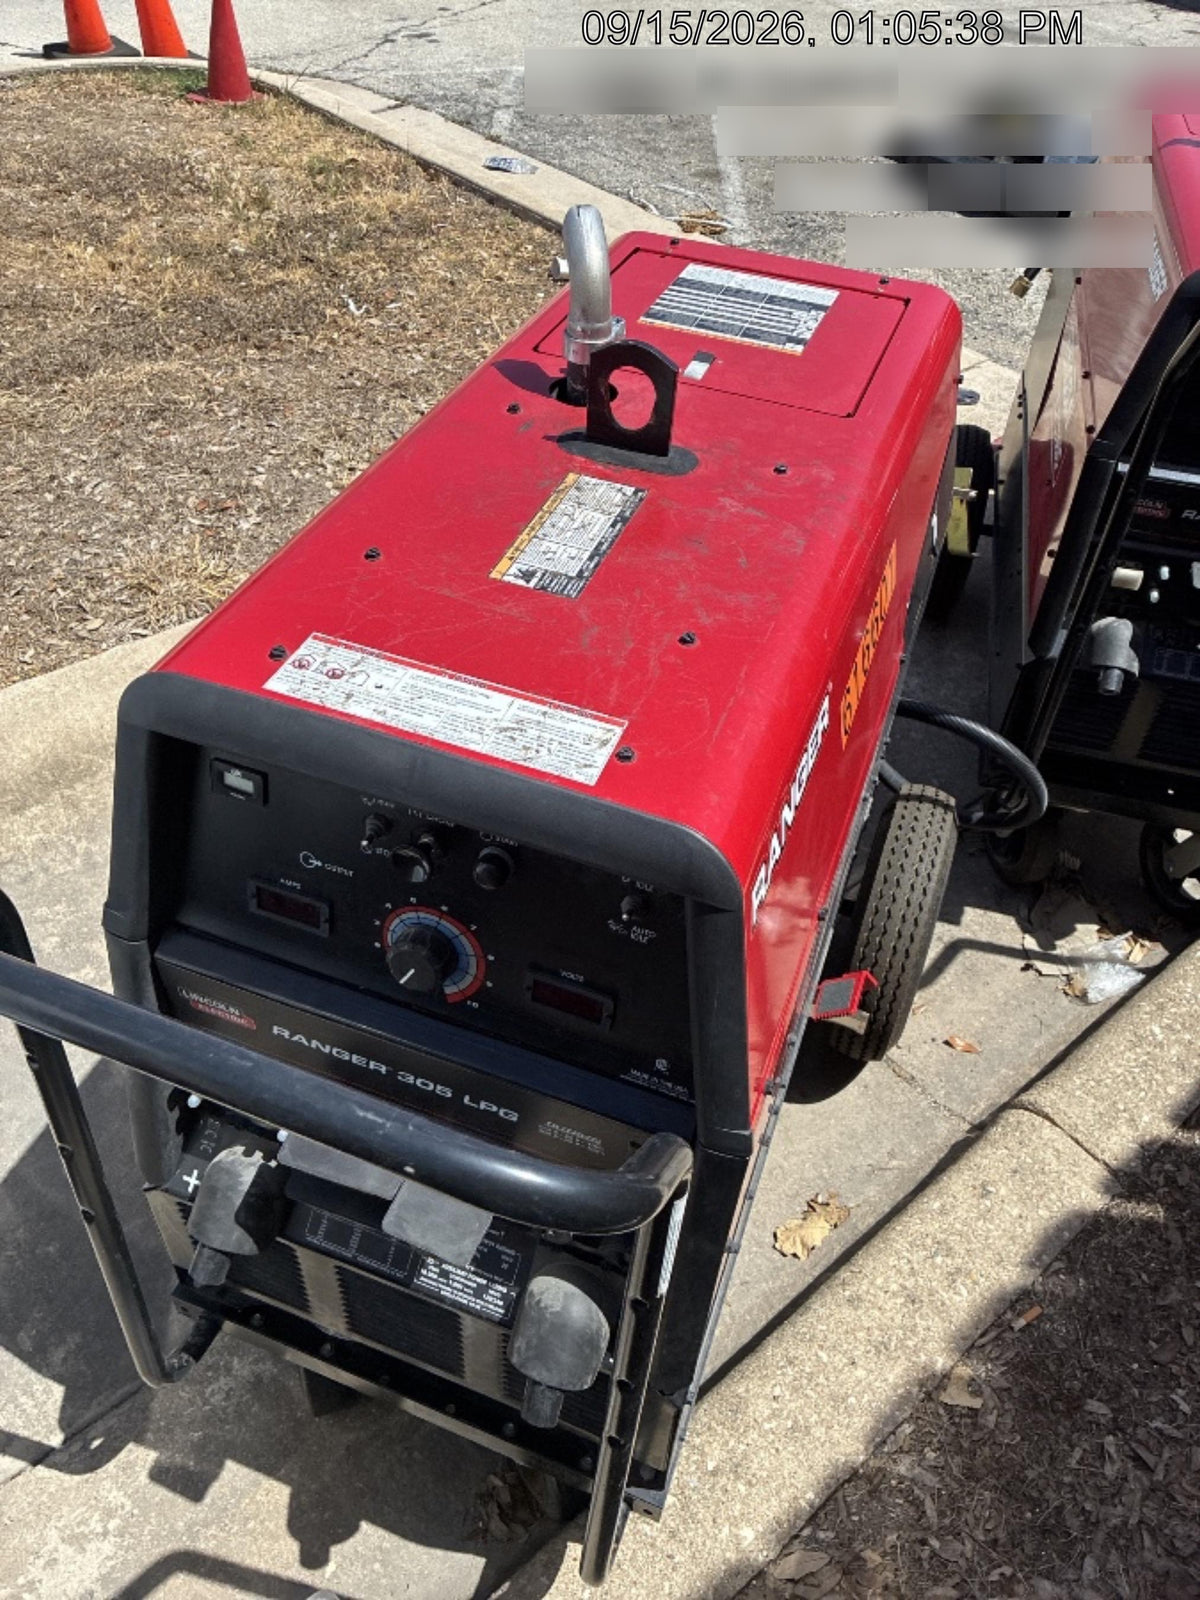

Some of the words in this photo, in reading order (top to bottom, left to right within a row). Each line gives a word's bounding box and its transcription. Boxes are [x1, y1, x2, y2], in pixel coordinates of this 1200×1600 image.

[752, 694, 829, 927] RANGER
[272, 1025, 387, 1076] RANGER
[397, 1071, 453, 1098] 305
[463, 1094, 520, 1123] LPG
